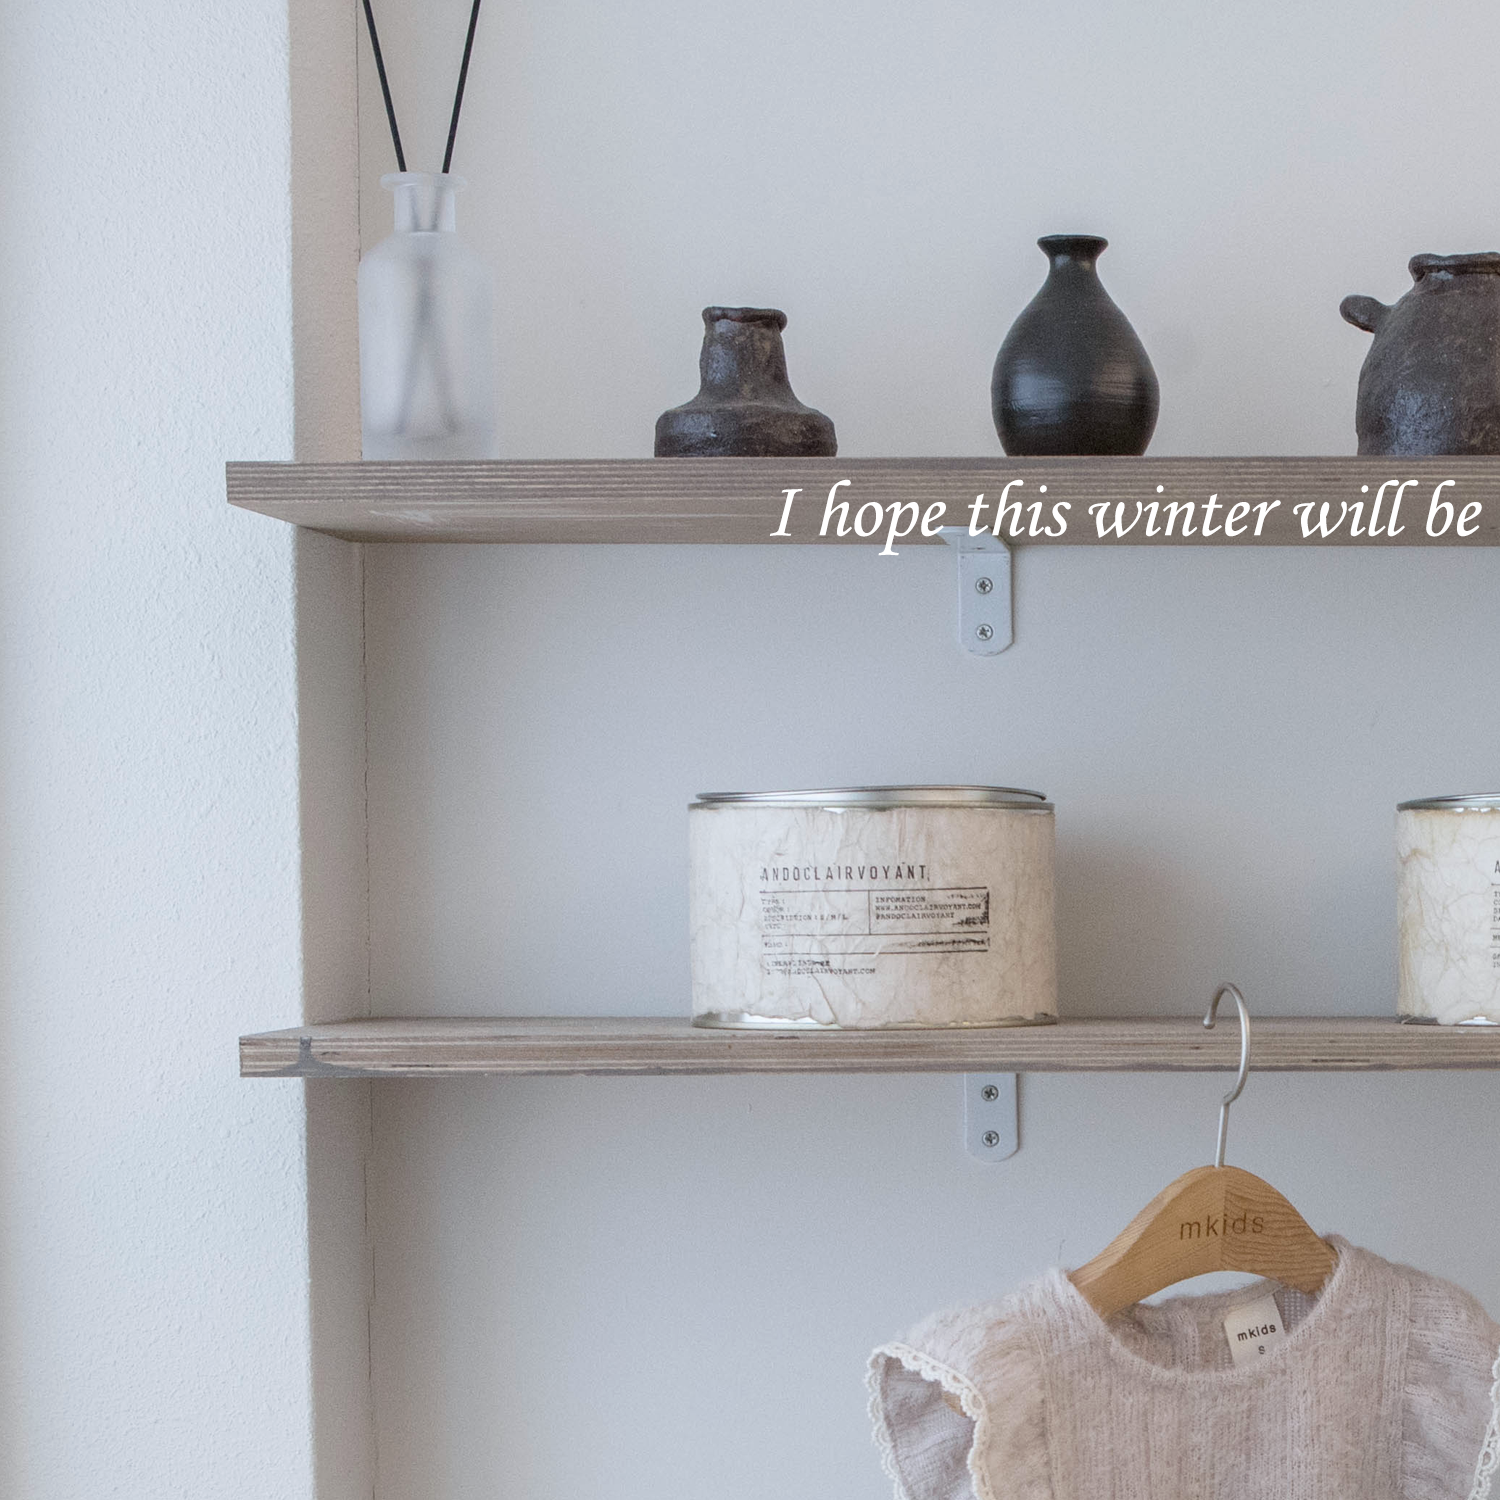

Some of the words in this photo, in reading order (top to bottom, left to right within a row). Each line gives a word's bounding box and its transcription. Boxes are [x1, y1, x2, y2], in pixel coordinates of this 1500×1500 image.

[762, 864, 927, 882] ANDOCLAIRVOYANT
[1179, 1212, 1265, 1240] mkids
[1237, 1323, 1277, 1342] mkids
[1258, 1345, 1266, 1355] S
